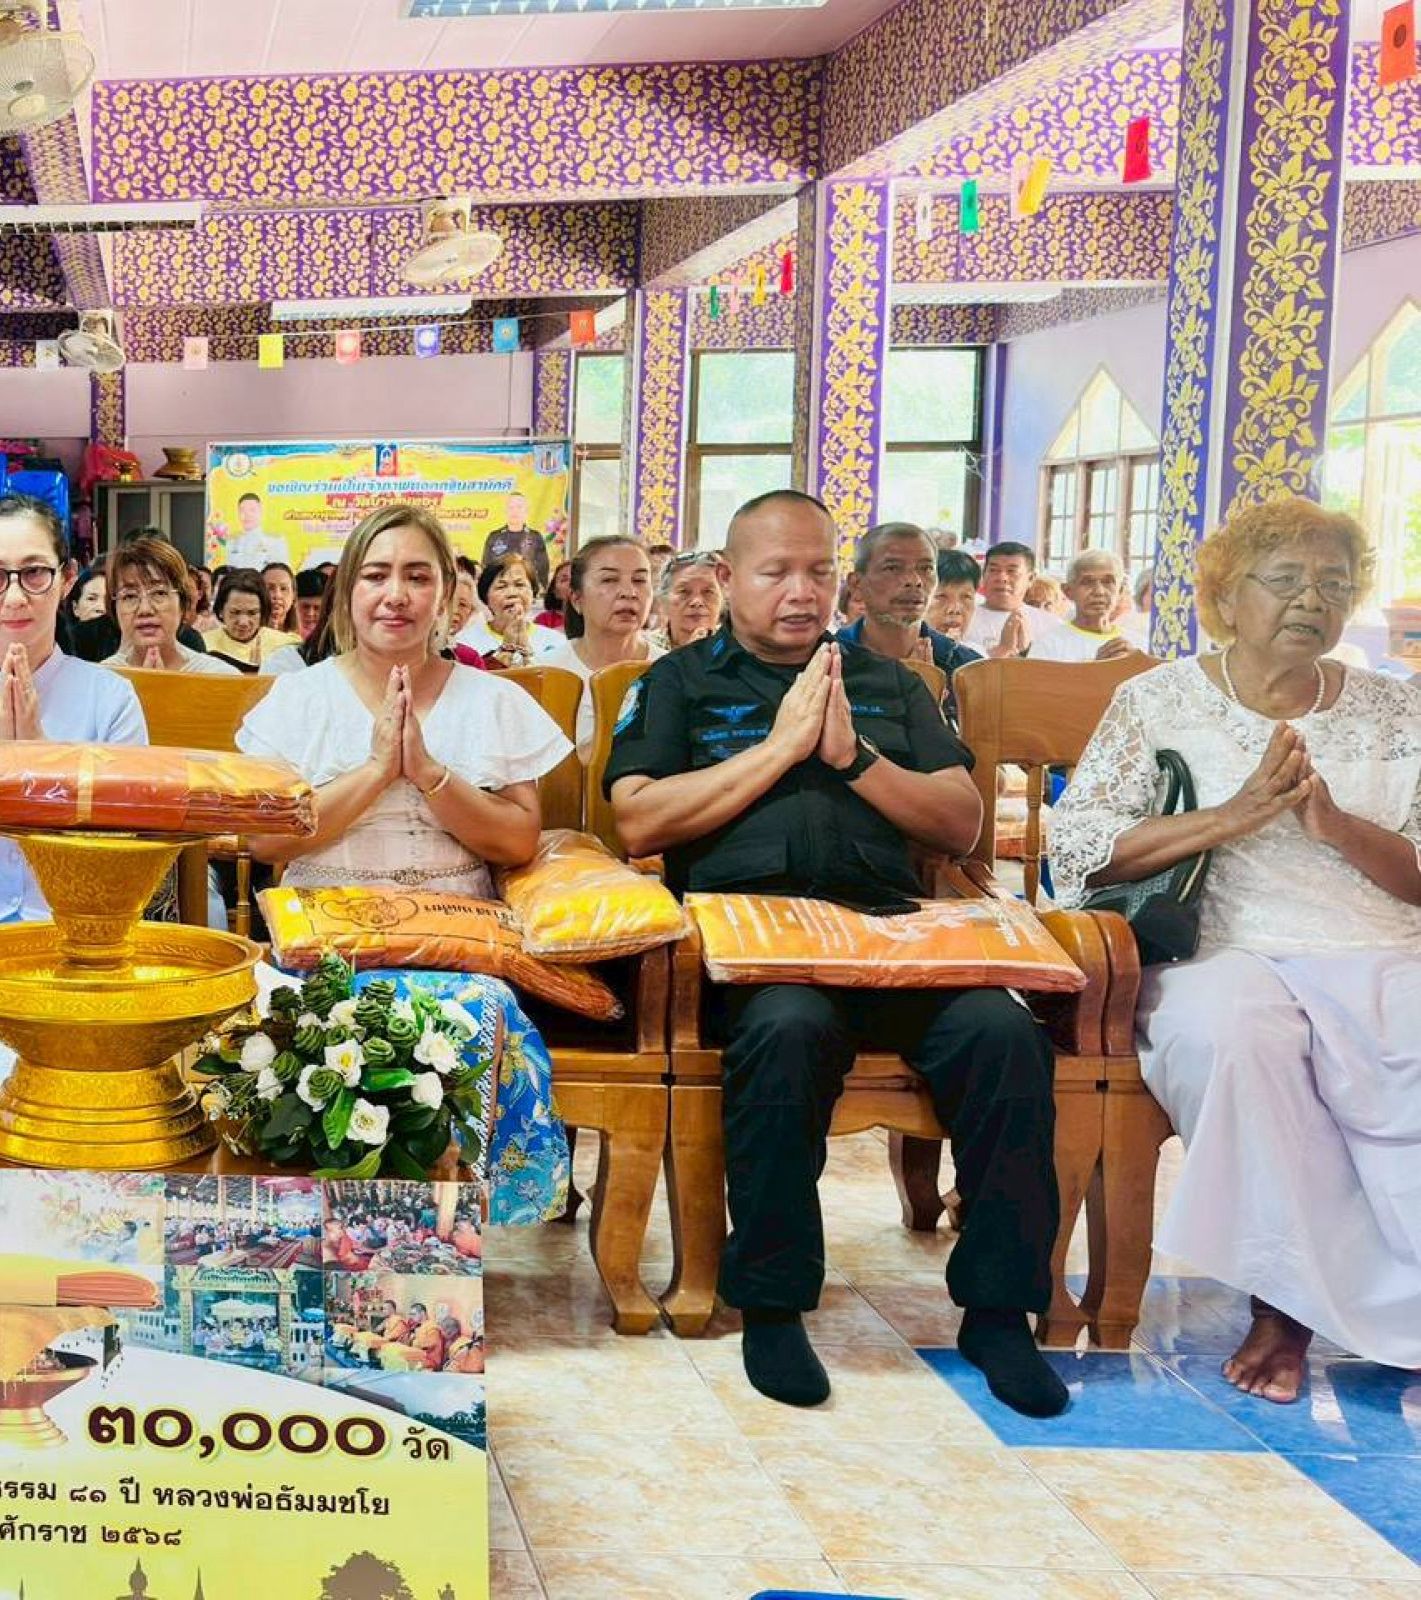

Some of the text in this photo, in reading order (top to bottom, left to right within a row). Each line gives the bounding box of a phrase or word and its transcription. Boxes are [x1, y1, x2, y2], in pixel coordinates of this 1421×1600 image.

[88, 1405, 386, 1459] ๓๐,๐๐๐
[402, 1426, 450, 1461] วัด
[69, 1485, 107, 1503] ๘๑
[119, 1476, 140, 1504] ปี
[153, 1483, 390, 1516] หลวงพ่อธัมมชโย
[100, 1525, 182, 1547] ๒๕๖๘
